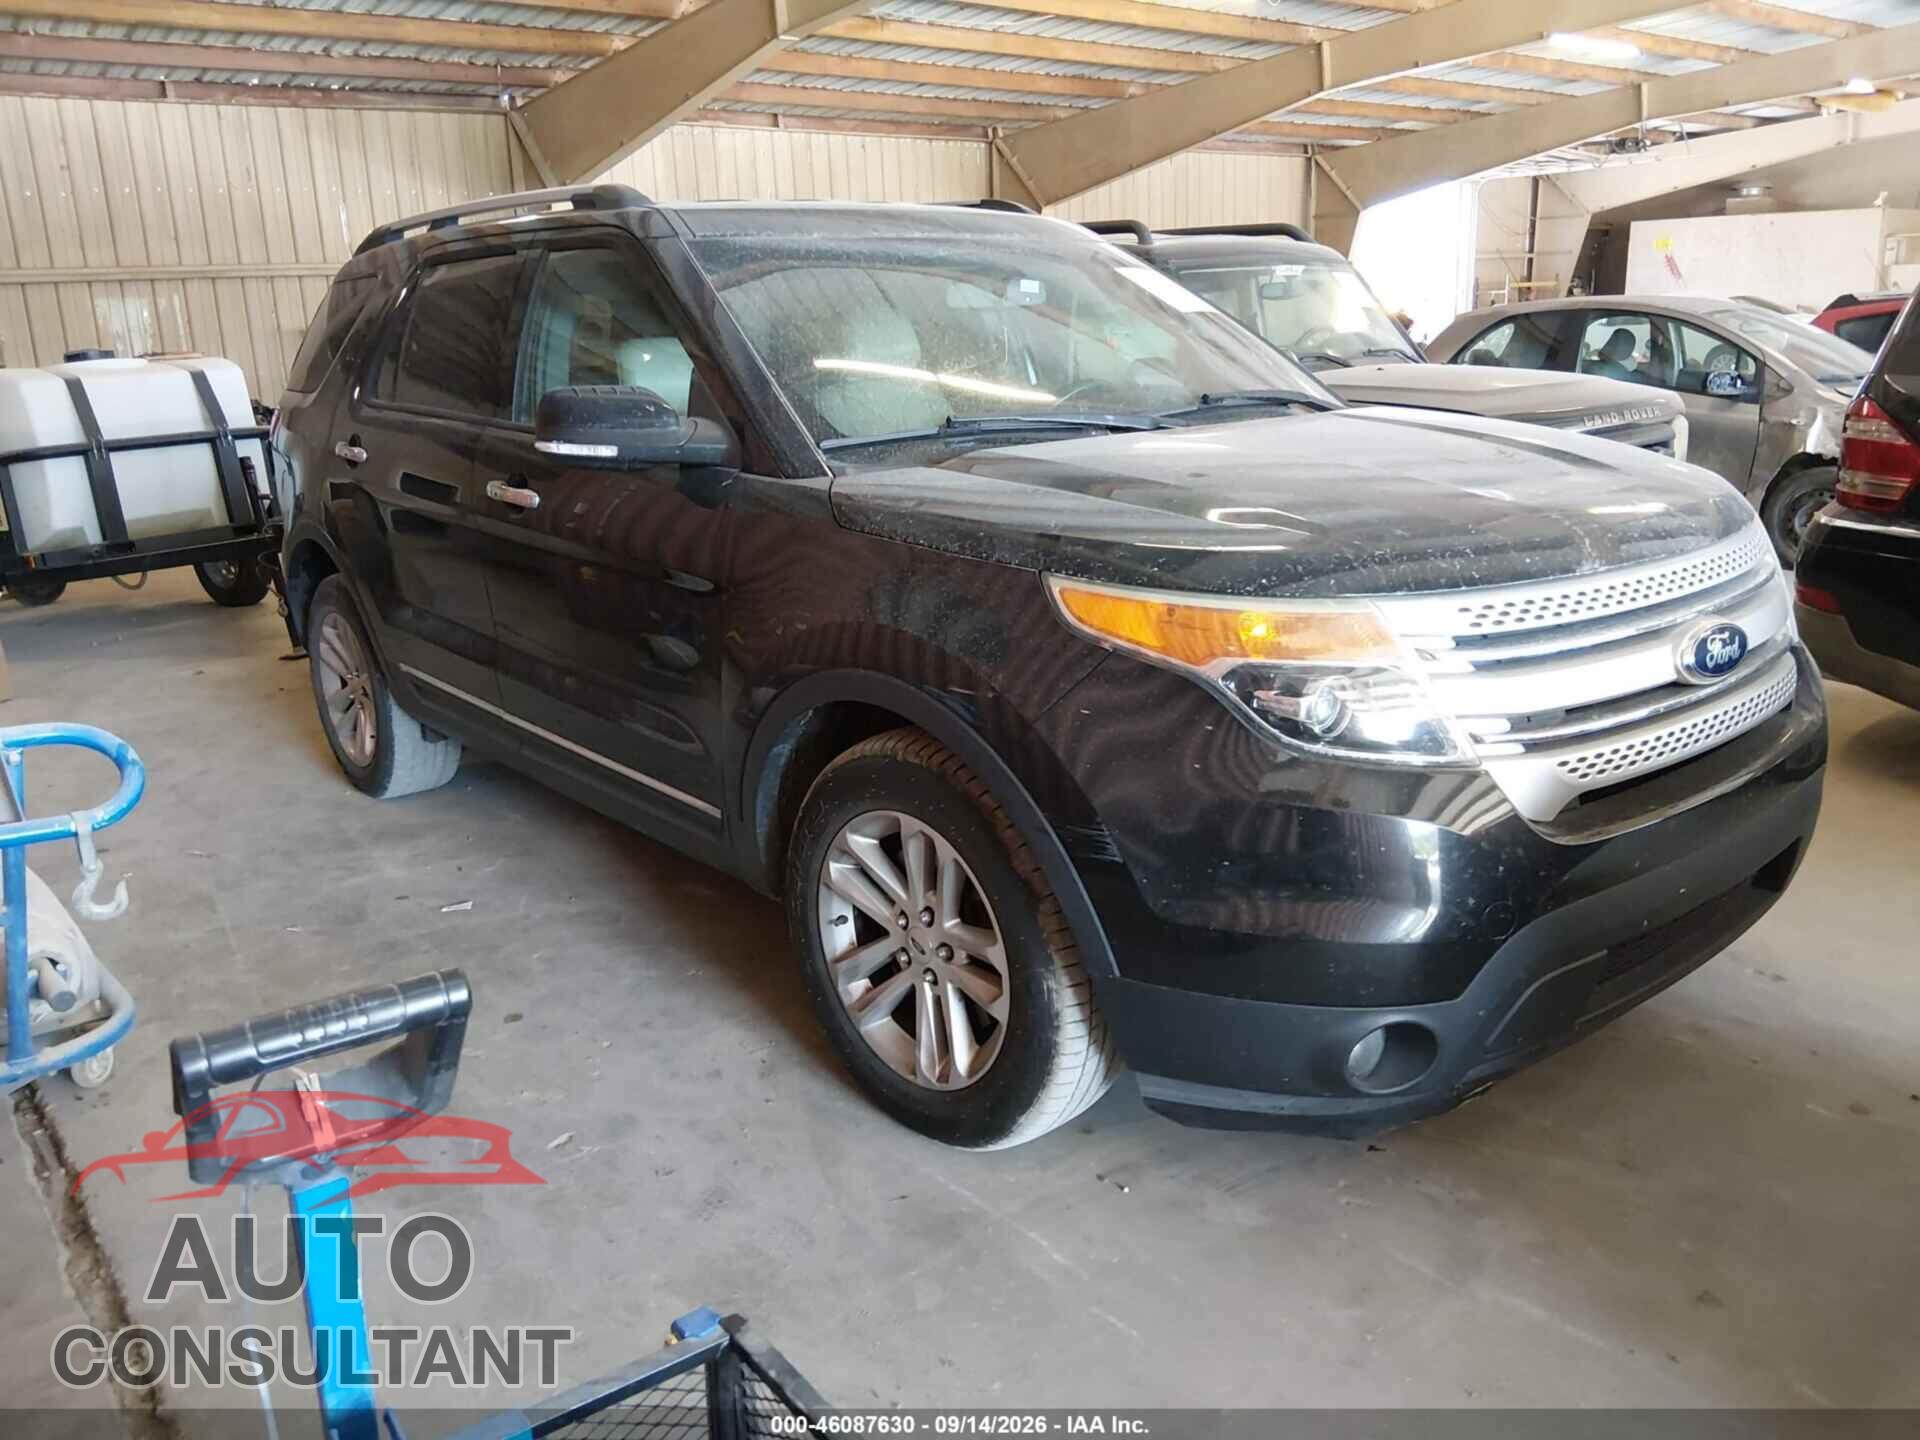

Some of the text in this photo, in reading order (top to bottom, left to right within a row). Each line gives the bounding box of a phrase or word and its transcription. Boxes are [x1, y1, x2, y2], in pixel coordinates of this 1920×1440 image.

[1583, 407, 1662, 427] LAND ROVER
[1706, 631, 1741, 669] Ford
